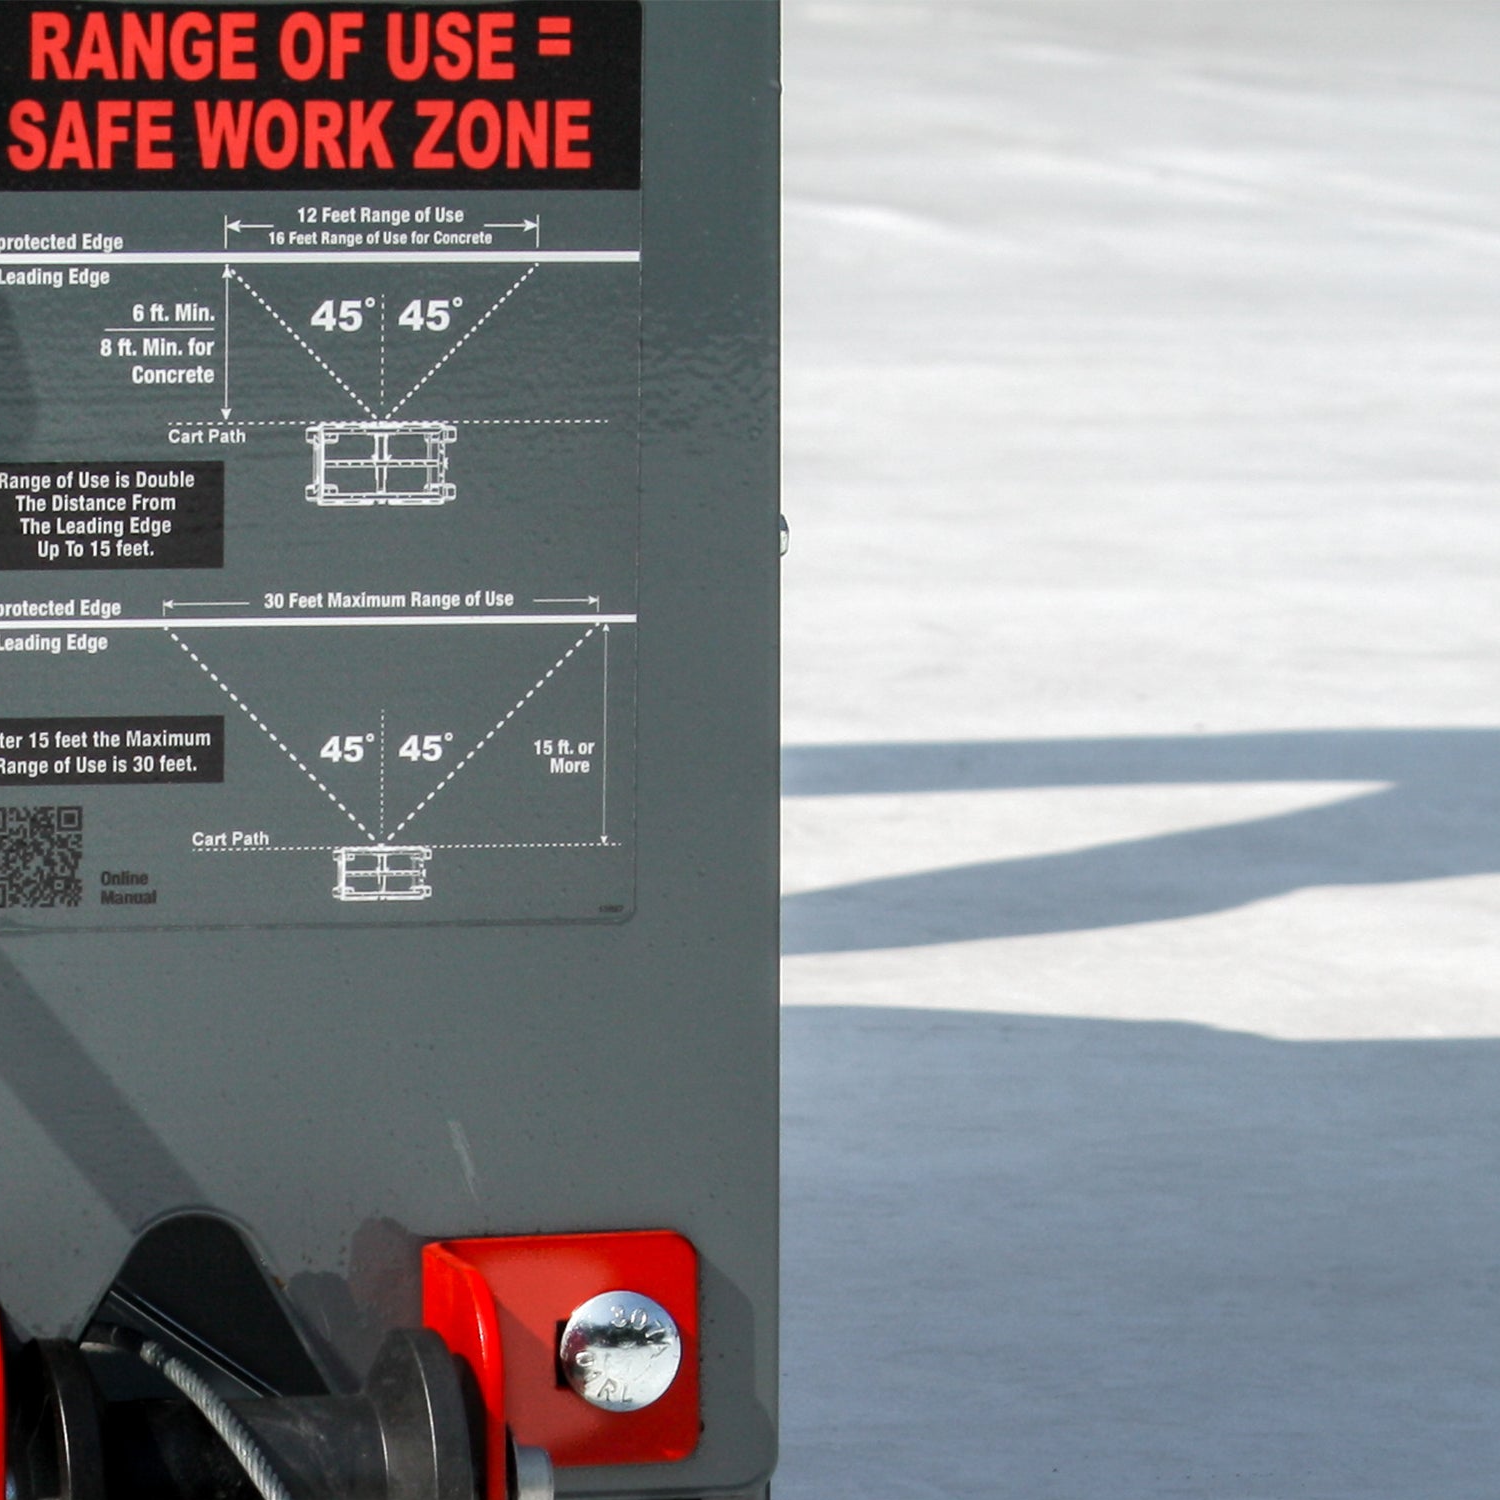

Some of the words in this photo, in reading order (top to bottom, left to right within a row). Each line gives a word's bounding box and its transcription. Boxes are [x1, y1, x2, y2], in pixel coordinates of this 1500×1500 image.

[30, 10, 258, 82] RANGE
[278, 10, 366, 82] OF
[386, 11, 517, 82] USE
[537, 16, 573, 56] =
[7, 98, 176, 171] SAFE
[193, 98, 396, 171] WORK
[412, 98, 593, 170] ZONE
[297, 207, 317, 223] 12
[322, 206, 357, 223] Feet
[360, 206, 411, 227] Range
[414, 206, 432, 223] of
[435, 206, 464, 223] Use
[82, 233, 124, 252] Edge
[268, 231, 285, 245] 16
[288, 231, 318, 245] Feet
[321, 231, 363, 248] Range
[366, 230, 380, 245] of
[383, 231, 408, 245] Use
[410, 230, 430, 245] for
[433, 230, 493, 245] Concrete
[68, 267, 110, 288] Edge
[132, 303, 145, 322] 6
[149, 303, 170, 322] ft.
[175, 302, 215, 322] Min.
[100, 338, 112, 357] 8
[117, 337, 137, 357] ft.
[142, 337, 183, 356] Min.
[187, 337, 215, 356] for
[132, 365, 215, 384] Concrete
[168, 428, 204, 444] Cart
[208, 428, 246, 444] Path
[56, 470, 74, 489] of
[78, 471, 110, 489] Use
[115, 470, 130, 489] is
[136, 470, 195, 488] Double
[15, 494, 47, 512] The
[52, 494, 127, 512] Distance
[132, 493, 176, 511] From
[19, 517, 51, 535] The
[56, 516, 124, 538] Leading
[130, 516, 172, 538] Edge
[37, 540, 60, 561] Up
[64, 540, 84, 558] To
[90, 540, 111, 557] 15
[115, 539, 155, 557] feet.
[80, 599, 122, 619] Edge
[264, 592, 285, 609] 30
[289, 592, 323, 609] Feet
[327, 591, 406, 608] Maximum
[411, 591, 461, 611] Range
[464, 590, 482, 607] of
[485, 590, 514, 607] Use
[66, 633, 108, 654] Edge
[28, 731, 50, 749] 15
[54, 730, 88, 749] feet
[92, 730, 121, 748] the
[126, 729, 211, 747] Maximum
[533, 739, 553, 756] 15
[557, 738, 574, 755] ft.
[577, 742, 596, 755] or
[53, 756, 71, 774] of
[76, 756, 107, 774] Use
[112, 755, 128, 773] is
[132, 755, 154, 773] 30
[159, 754, 197, 772] feet.
[550, 757, 590, 774] More
[192, 831, 227, 847] Cart
[232, 830, 270, 846] Path
[100, 870, 149, 886] Online
[100, 890, 157, 905] Manual
